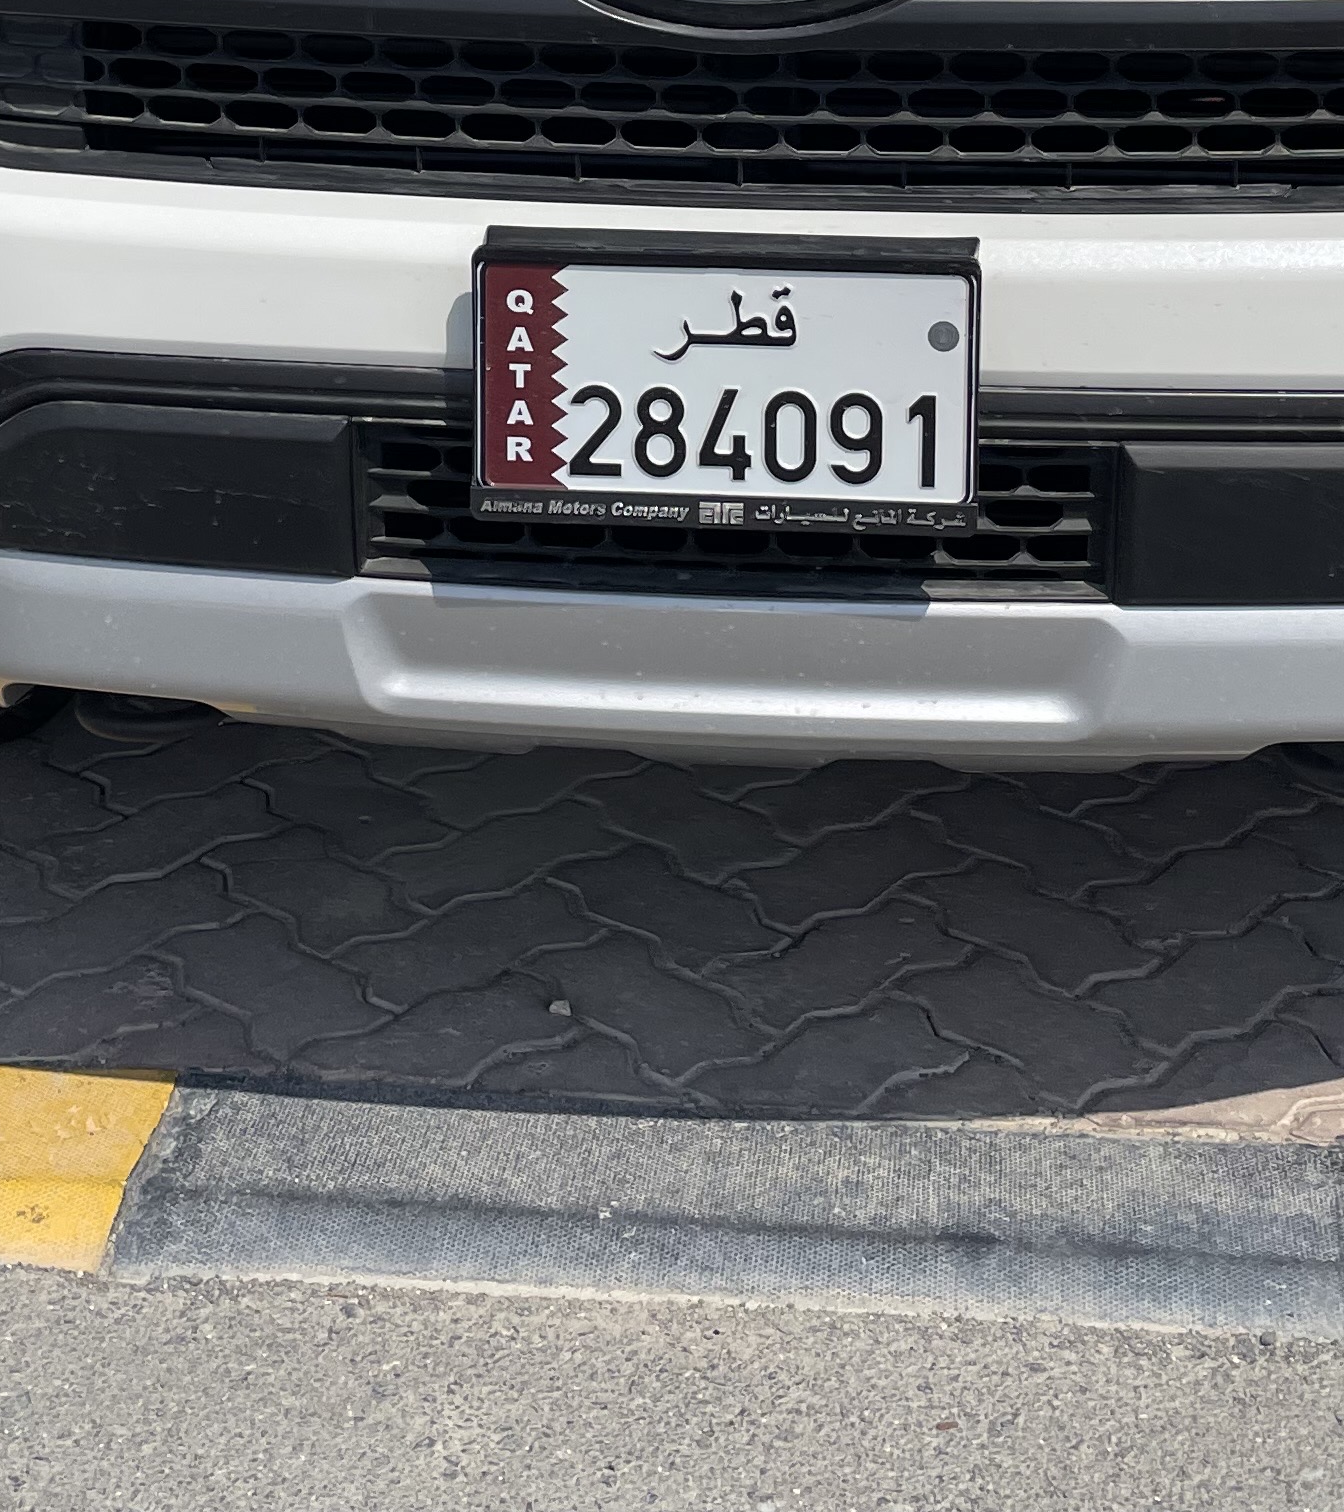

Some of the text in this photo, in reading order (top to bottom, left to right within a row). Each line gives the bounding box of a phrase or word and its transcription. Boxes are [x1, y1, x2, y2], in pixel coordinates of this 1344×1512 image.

[653, 284, 798, 363] قطر
[505, 289, 533, 462] QATAR
[569, 384, 938, 490] 284091
[481, 498, 690, 522] Almana Motors Company
[906, 507, 966, 530] شركة
